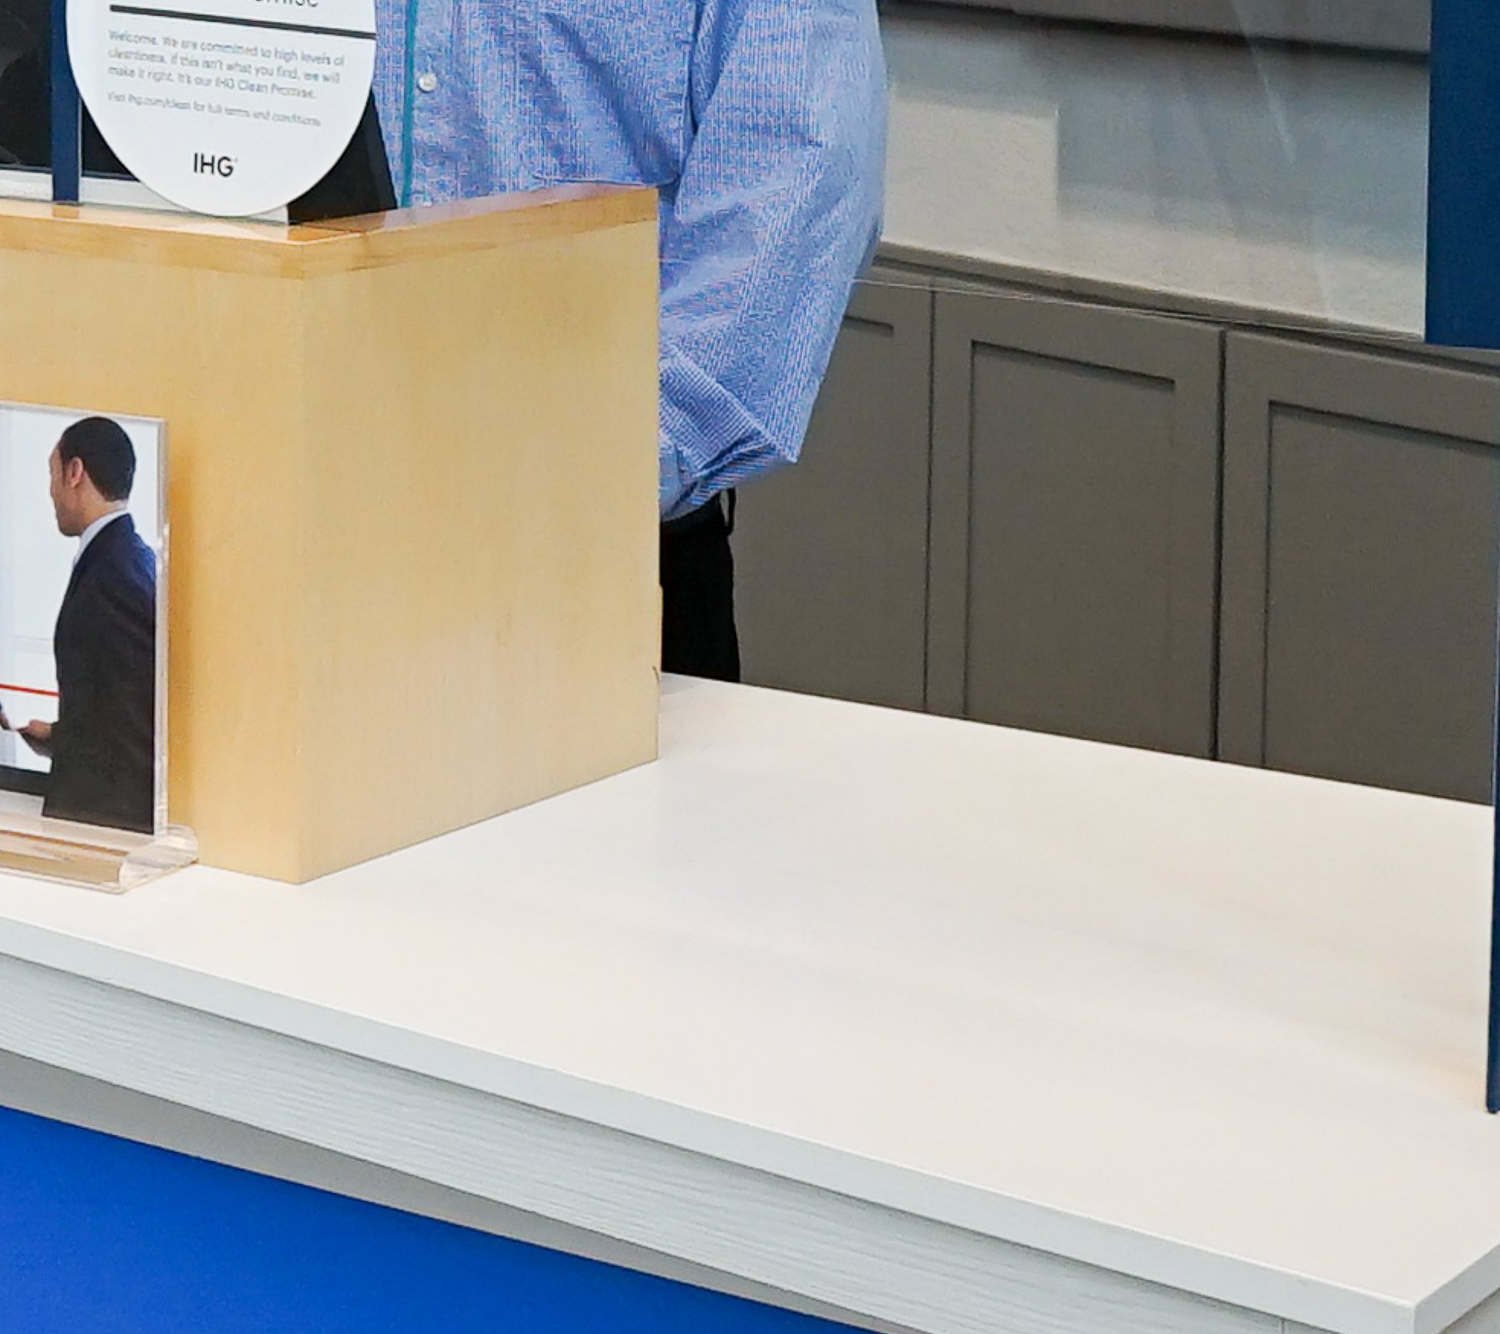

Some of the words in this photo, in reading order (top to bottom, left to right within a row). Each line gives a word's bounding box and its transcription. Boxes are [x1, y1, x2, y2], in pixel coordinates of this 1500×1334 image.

[162, 36, 179, 48] We
[261, 47, 271, 58] to
[274, 47, 298, 63] high
[301, 50, 331, 65] levels
[108, 66, 136, 78] make
[194, 77, 212, 87] our
[215, 76, 234, 90] IHG
[237, 79, 268, 93] Clean
[180, 55, 199, 67] this
[226, 61, 252, 74] what
[255, 66, 274, 77] you
[303, 72, 319, 81] we
[322, 72, 340, 83] will
[193, 153, 234, 178] IHG
